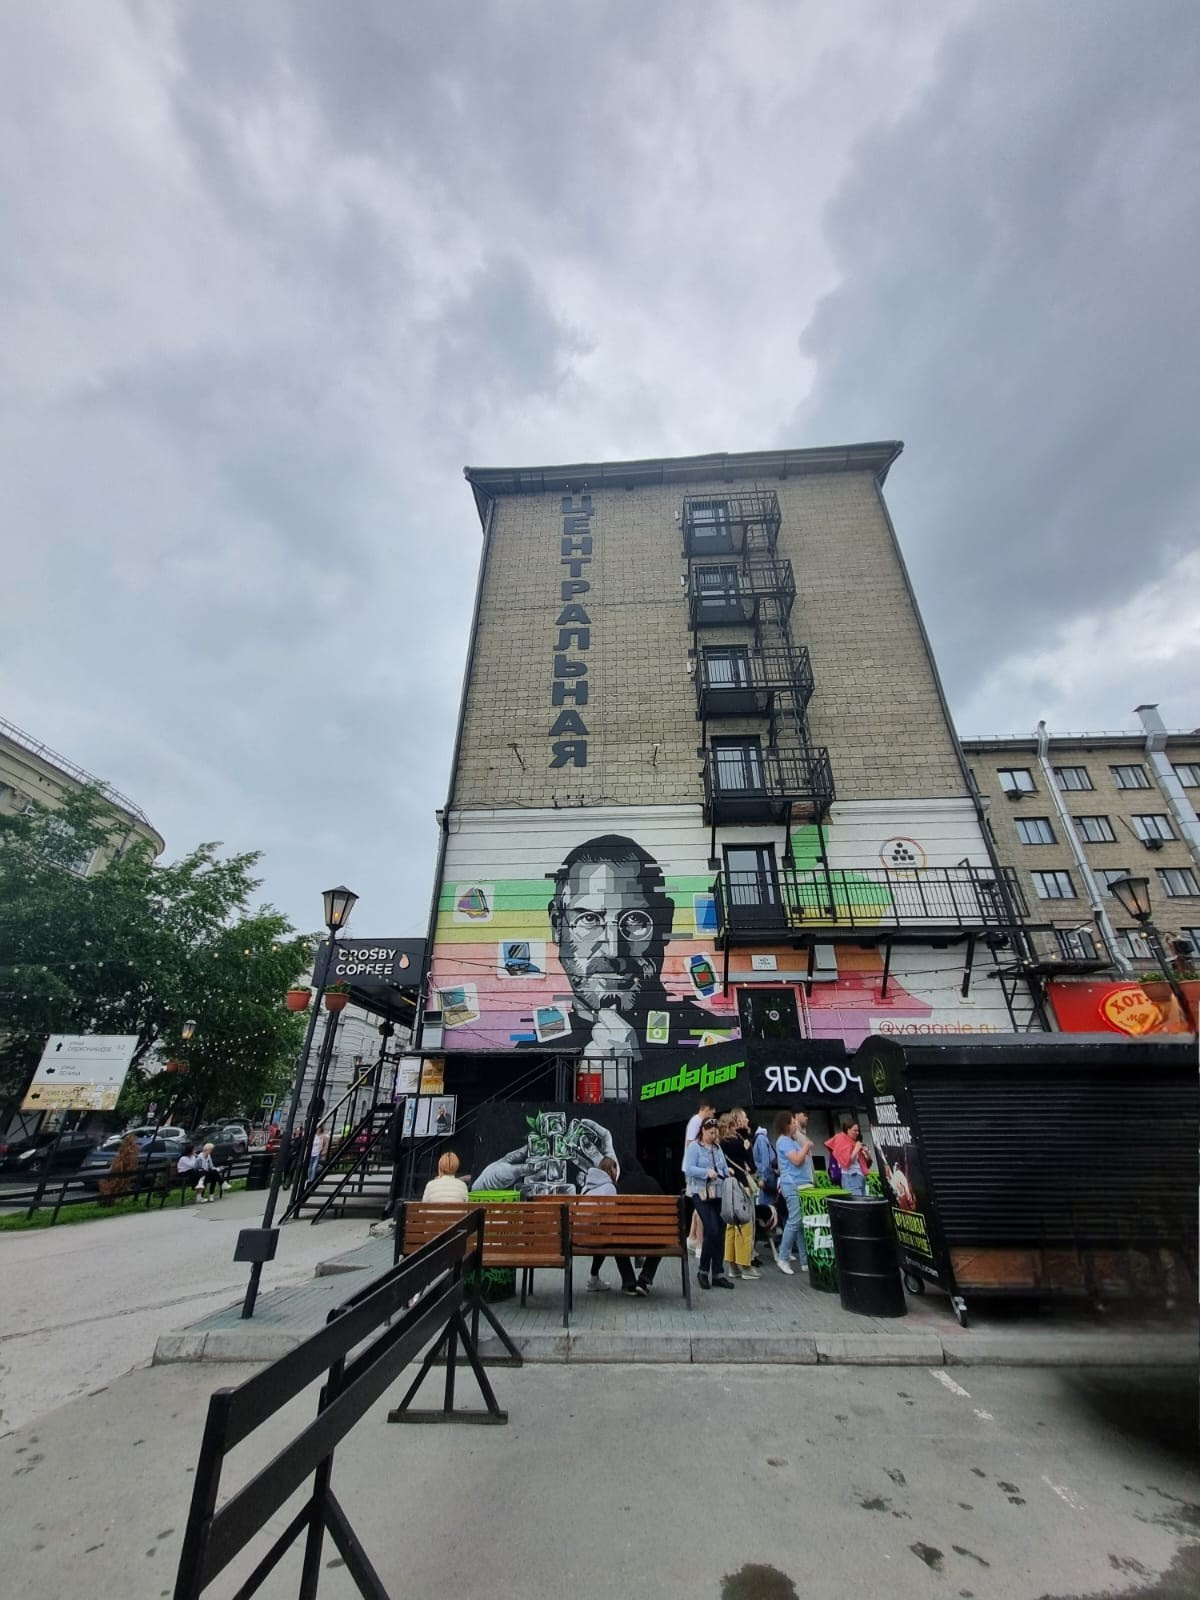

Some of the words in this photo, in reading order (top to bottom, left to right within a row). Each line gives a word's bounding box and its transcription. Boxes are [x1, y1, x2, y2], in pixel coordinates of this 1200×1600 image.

[549, 495, 594, 768] ЦЕНТРАЛЬНАЯ
[338, 948, 396, 961] CROSBY
[640, 1060, 745, 1101] sodabar
